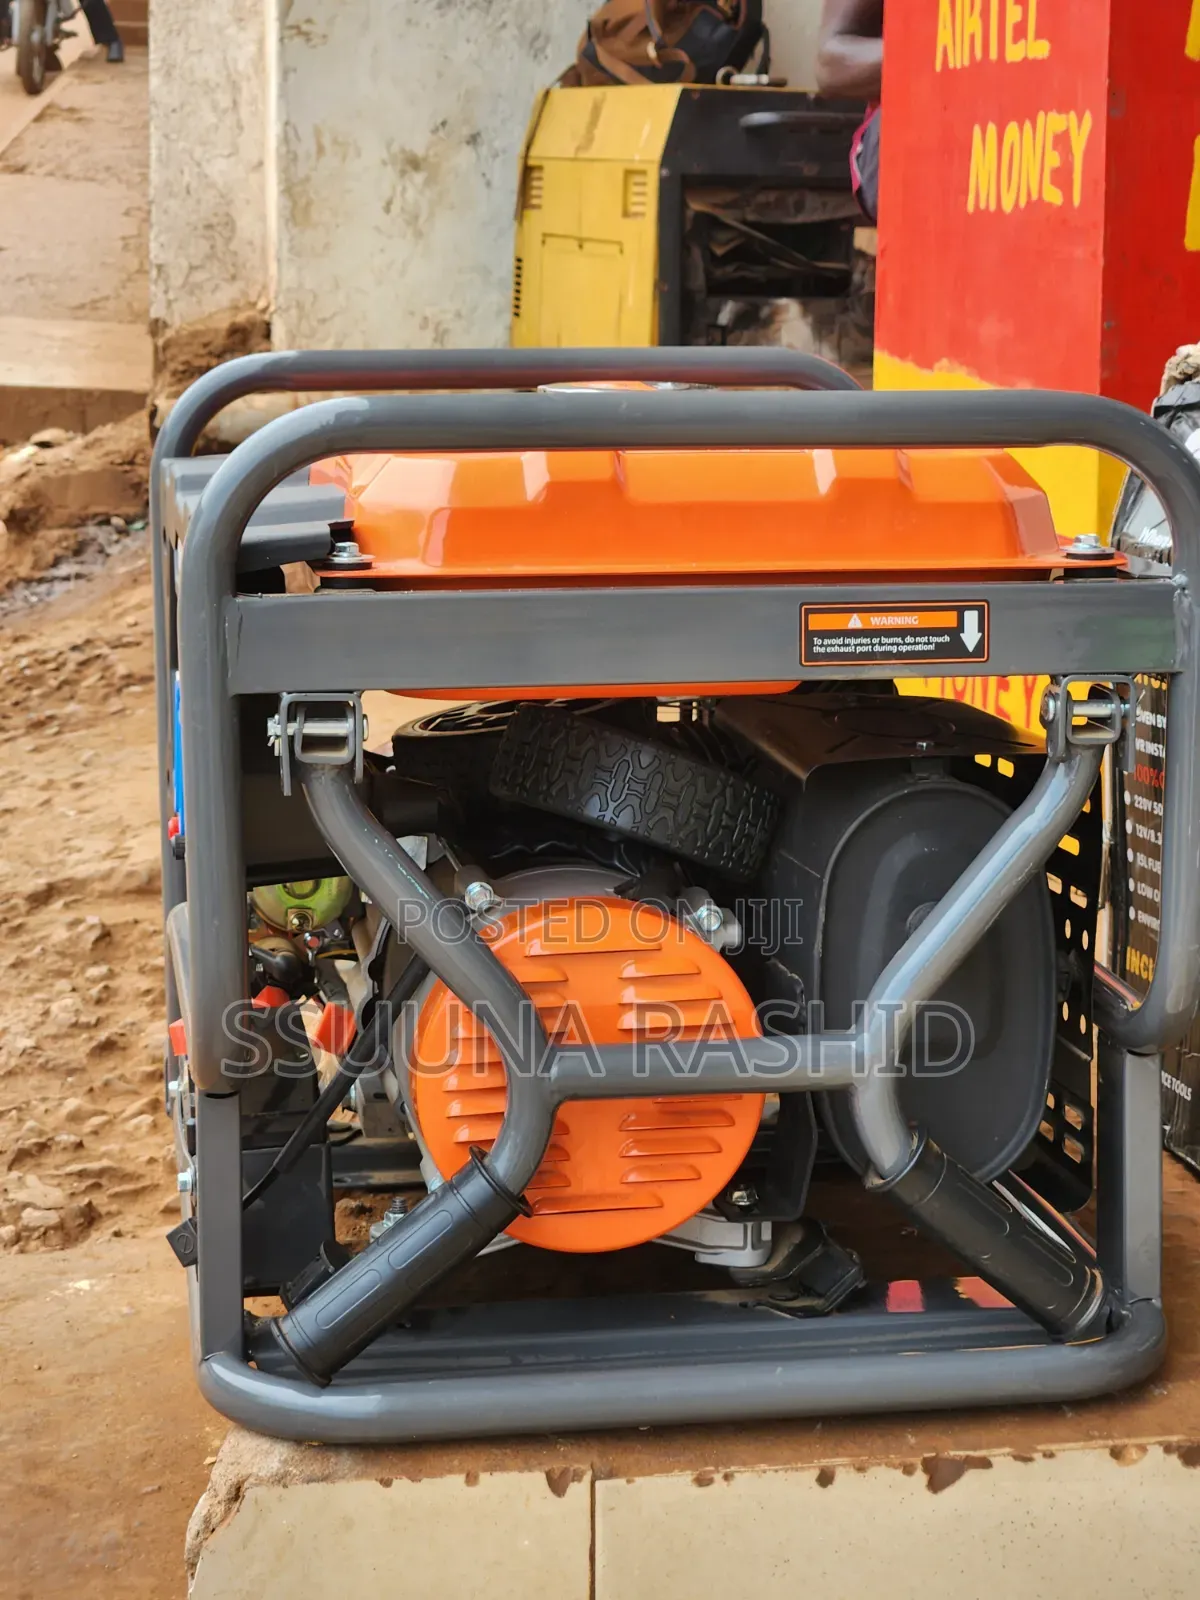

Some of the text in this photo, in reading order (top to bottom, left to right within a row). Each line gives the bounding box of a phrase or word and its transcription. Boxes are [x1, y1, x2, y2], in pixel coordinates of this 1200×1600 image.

[967, 110, 1092, 214] MONEY
[870, 615, 919, 626] WARNING
[813, 637, 822, 645] To
[823, 637, 843, 645] avoid
[844, 636, 871, 646] injuries
[881, 636, 903, 645] burns,
[904, 635, 915, 643] do
[916, 635, 928, 643] not
[929, 635, 950, 643] touch
[813, 643, 935, 654] the exhaust port during operation!
[1137, 880, 1153, 900] LOW
[1171, 1077, 1193, 1101] TOOLS
